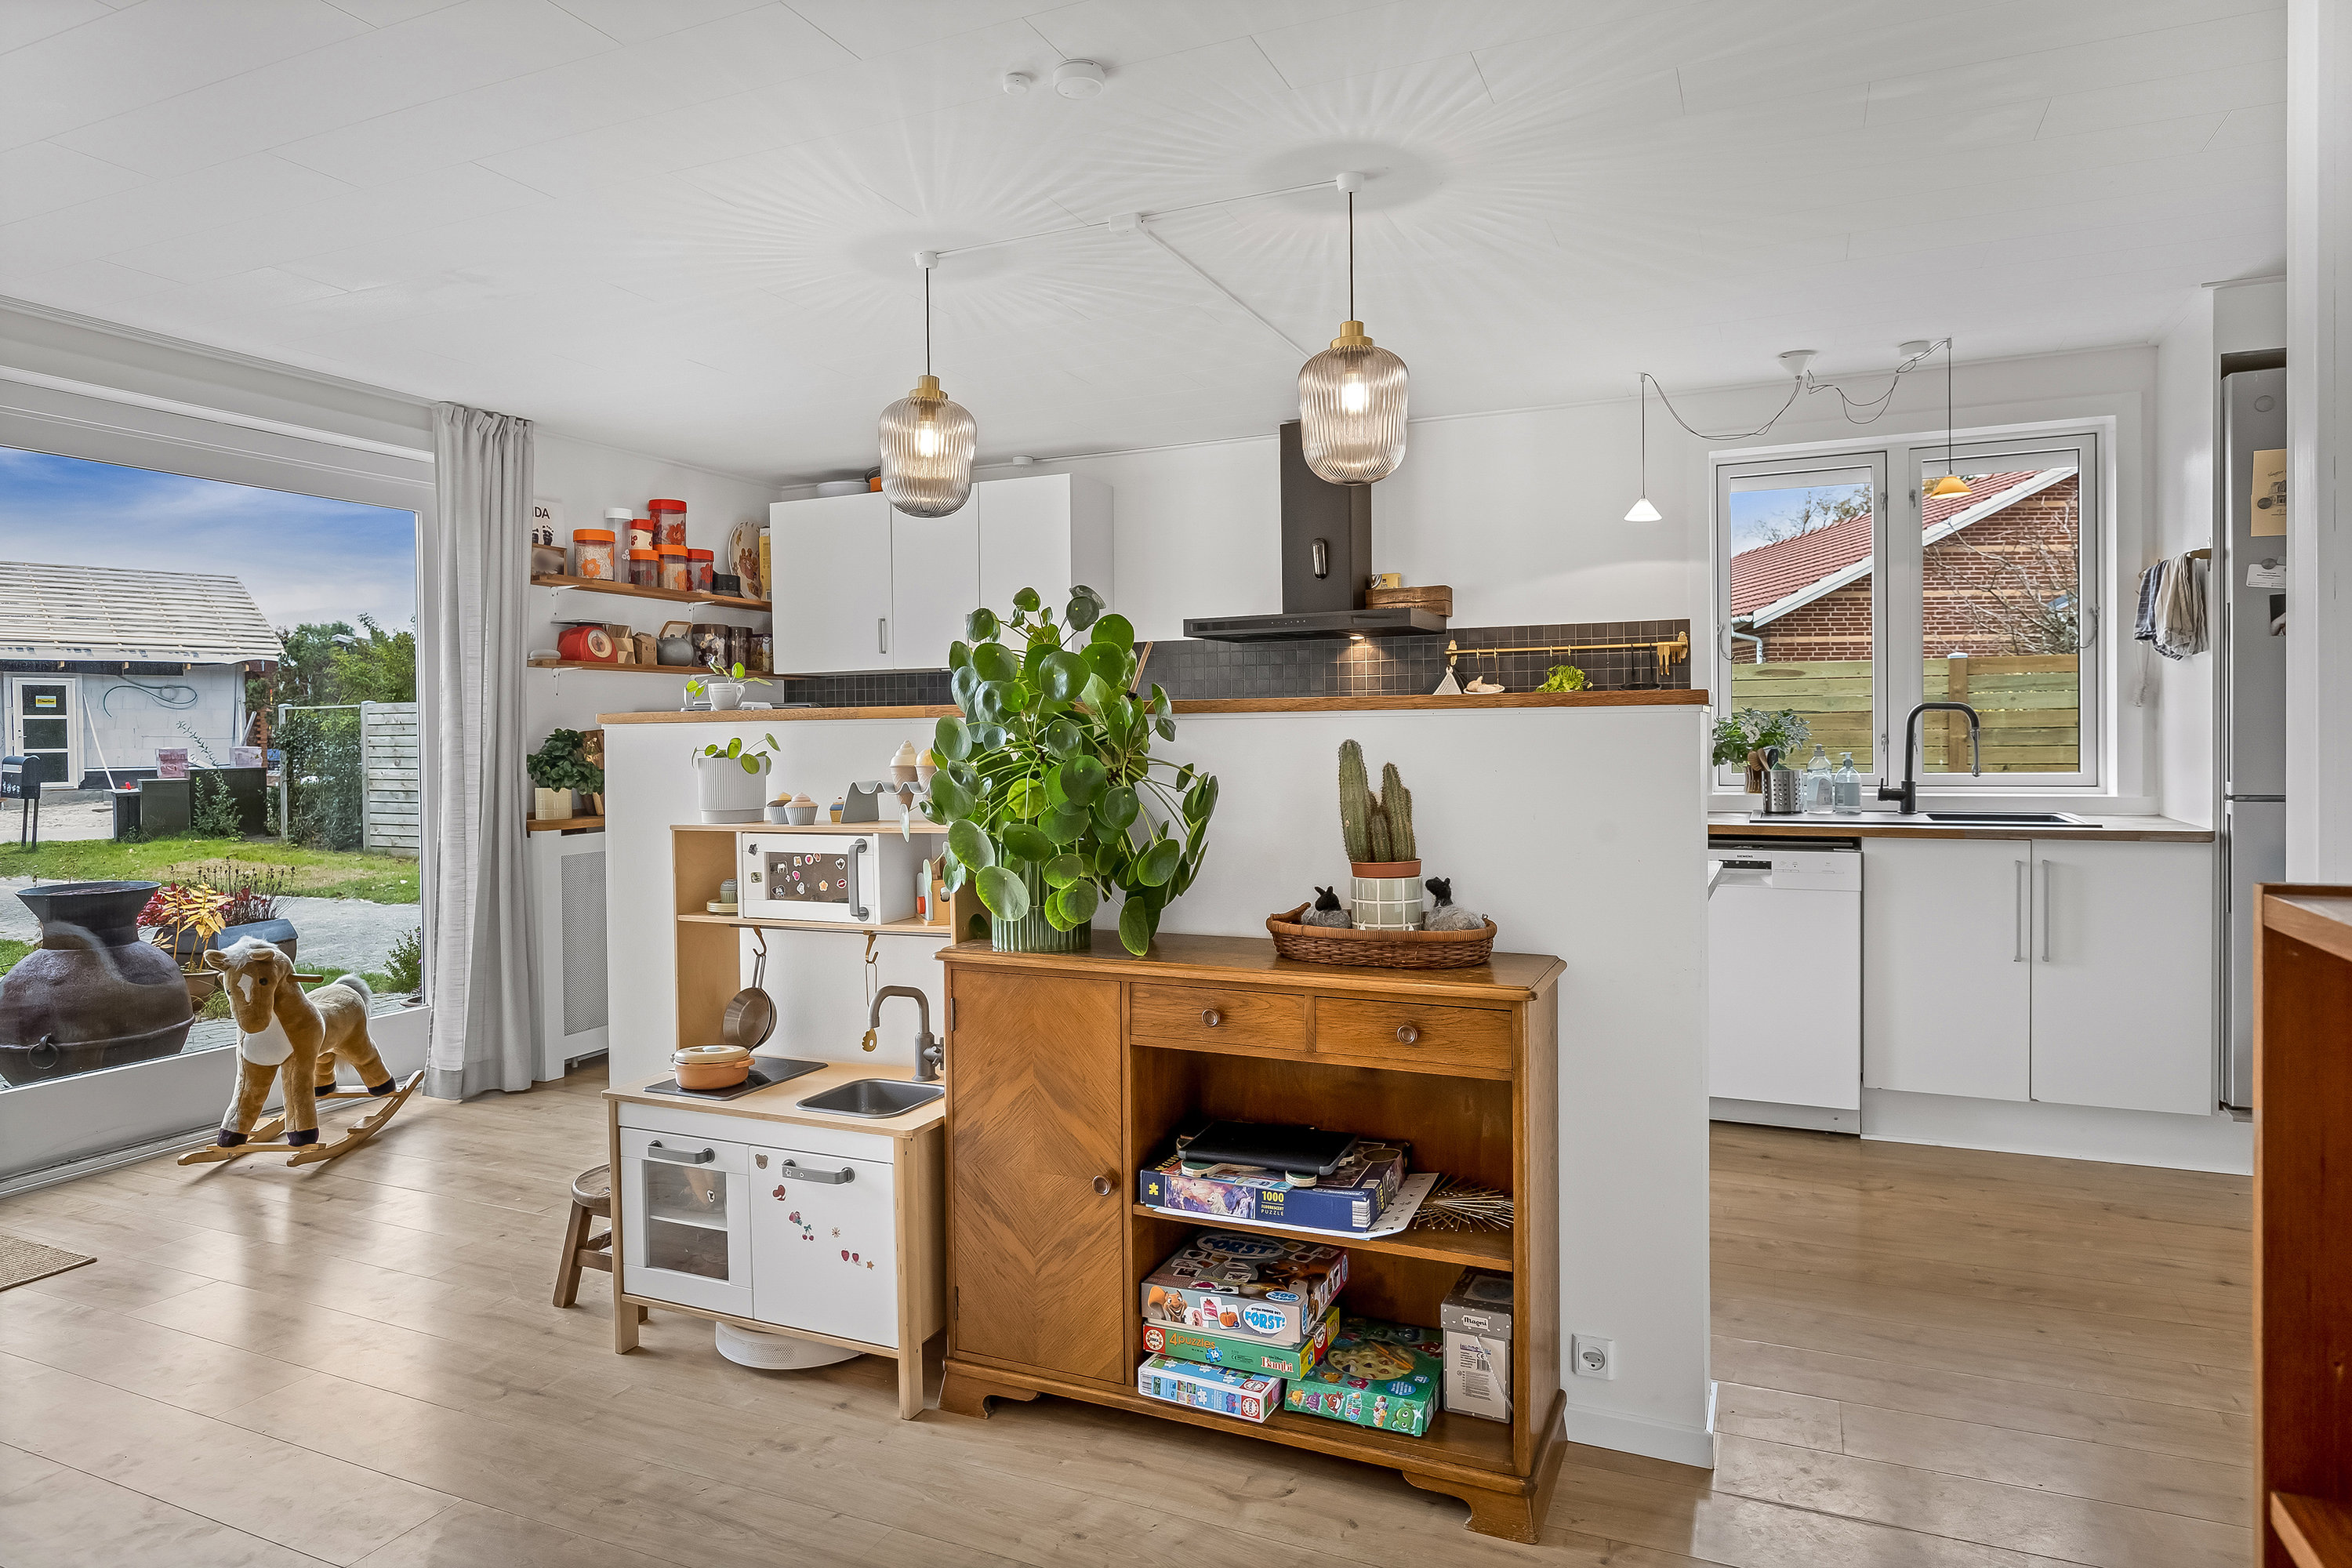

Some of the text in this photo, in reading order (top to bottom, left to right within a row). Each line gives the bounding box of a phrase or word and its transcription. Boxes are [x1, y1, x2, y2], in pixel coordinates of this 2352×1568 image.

[1261, 1191, 1284, 1203] 1000
[1245, 1311, 1285, 1330] FØRST!
[1464, 1316, 1487, 1327] Magni
[1261, 1356, 1294, 1374] Bambi
